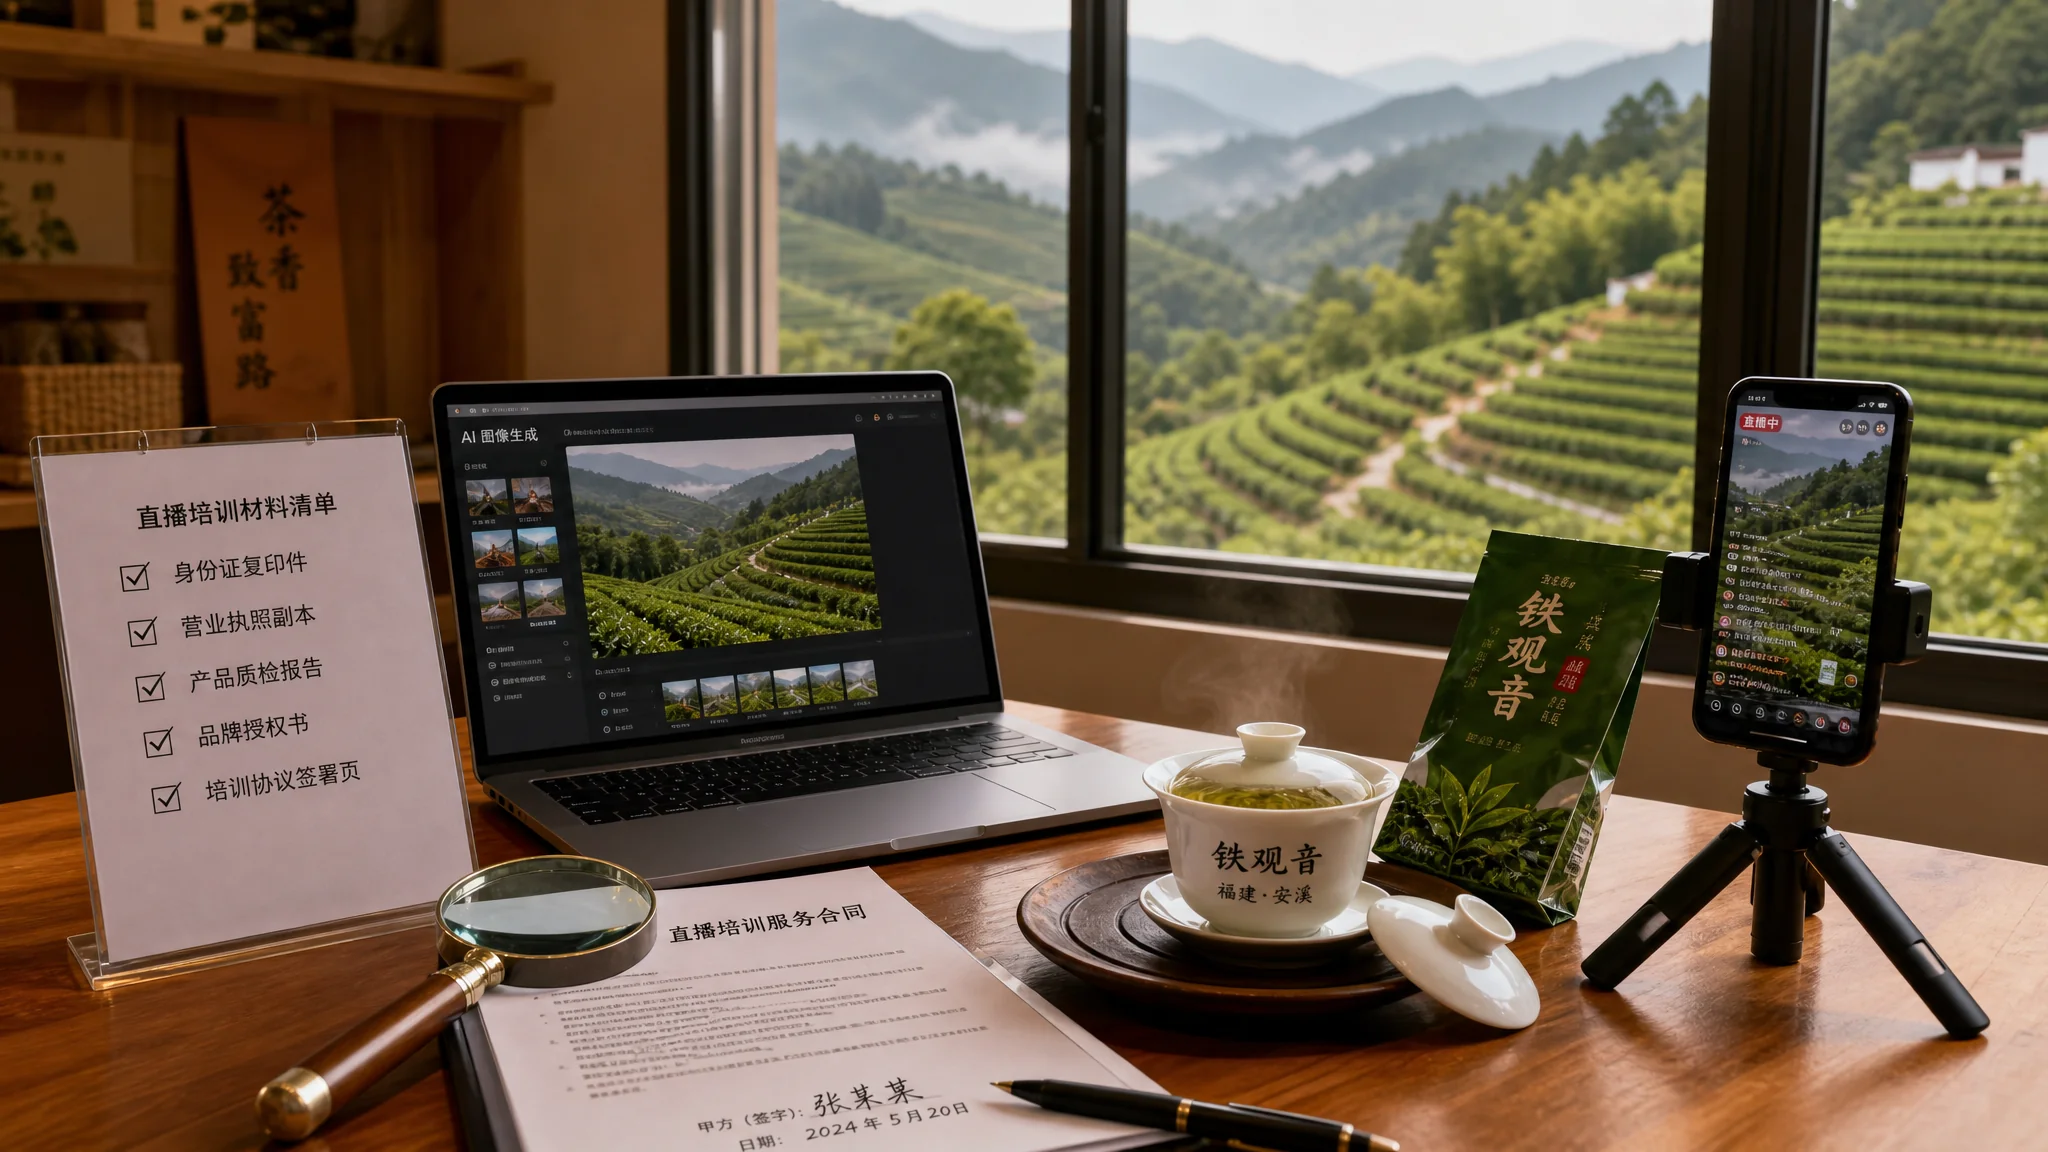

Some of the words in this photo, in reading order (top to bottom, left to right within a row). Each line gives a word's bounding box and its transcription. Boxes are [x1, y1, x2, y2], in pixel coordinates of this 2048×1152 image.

[259, 184, 307, 291] 茶香
[228, 252, 276, 389] 致富路
[461, 430, 476, 443] AI
[481, 427, 539, 443] 图像生成
[136, 492, 337, 530] 直播培训材料清单
[174, 551, 307, 584] 身份证复印件
[181, 603, 316, 638] 营业执照副本
[190, 656, 323, 693] 产品质检报告
[1487, 590, 1564, 721] 铁观音
[198, 712, 309, 748] 品牌授权书
[205, 760, 361, 802] 培训协议签署页
[1211, 840, 1322, 875] 铁观音
[669, 903, 867, 943] 直播培训服务合同
[813, 1077, 924, 1117] 张某某
